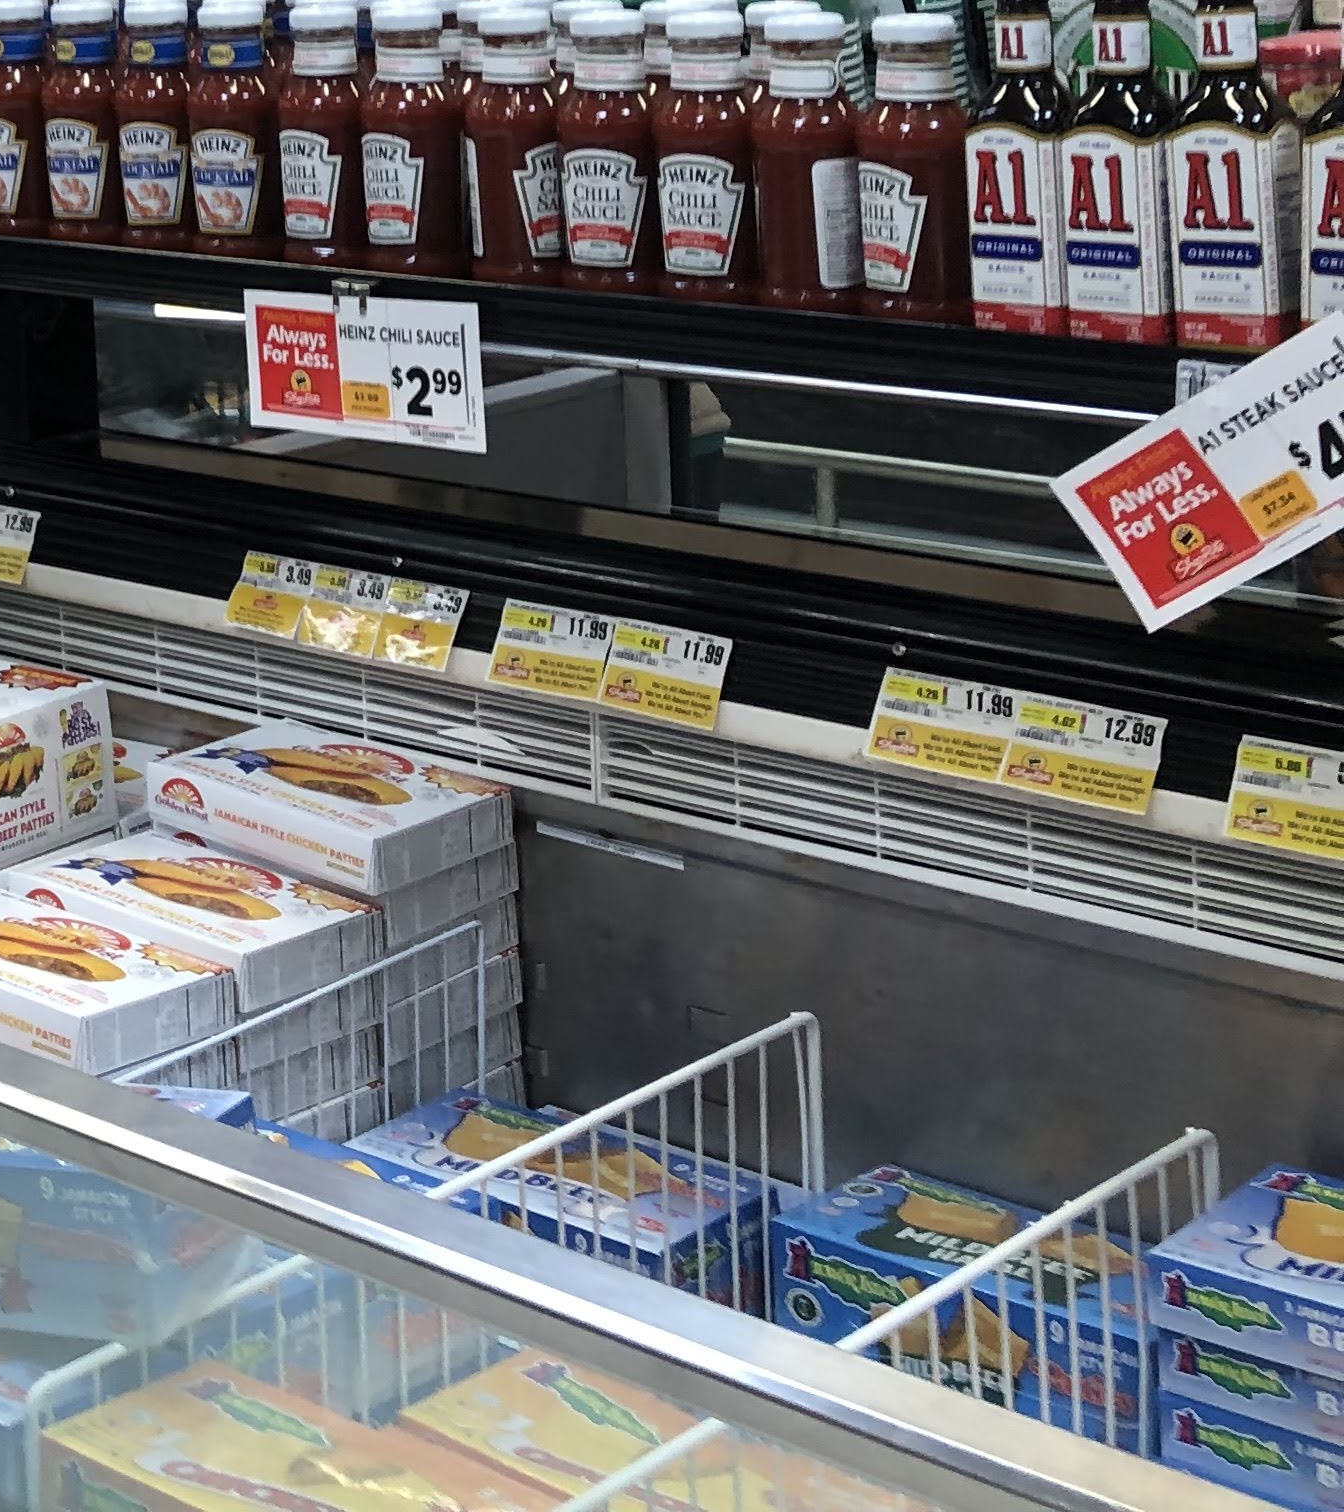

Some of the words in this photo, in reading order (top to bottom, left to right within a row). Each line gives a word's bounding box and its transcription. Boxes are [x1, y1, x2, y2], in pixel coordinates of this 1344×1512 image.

[125, 131, 164, 146] HEINZ
[199, 138, 239, 153] HEINZ
[573, 160, 623, 181] HEINZ
[669, 165, 718, 185] HEINZ
[574, 182, 622, 201] CHILI
[974, 149, 1036, 226] A1
[1069, 153, 1134, 232] A1
[1183, 149, 1255, 231] A1
[669, 190, 717, 209] CHILI
[571, 202, 626, 221] SAUCE
[667, 208, 722, 228] SAUCE
[976, 240, 1035, 256] ORIGINAL
[1070, 248, 1132, 262] ORIGINAL
[1187, 247, 1253, 261] ORIGINAL
[267, 324, 327, 352] Always
[339, 324, 374, 341] HEINZ
[380, 326, 412, 345] CHILI
[417, 329, 460, 347] SAUCE
[263, 344, 289, 364] For
[295, 347, 334, 370] Less.
[1197, 428, 1222, 457] A1
[1219, 391, 1285, 440] STEAK
[1282, 354, 1344, 403] SAUCE
[1108, 459, 1193, 521] Always
[5, 514, 33, 533] 12.99
[1113, 514, 1155, 548] For
[1155, 486, 1219, 523] Less.
[286, 565, 312, 586] 3.49
[357, 579, 384, 600] 3.49
[569, 616, 609, 640] 11.99
[683, 638, 725, 666] 11.99
[966, 689, 1013, 718] 11.99
[1104, 717, 1156, 746] 12.99
[20, 798, 45, 819] STYLE
[21, 812, 54, 835] PATTIES
[214, 807, 260, 832] JAMAICAN
[260, 824, 285, 841] STYLE
[286, 831, 327, 855] CHICKEN
[329, 848, 365, 868] PATTIES
[35, 1026, 71, 1049] PATTIES
[1049, 1319, 1065, 1344] 9
